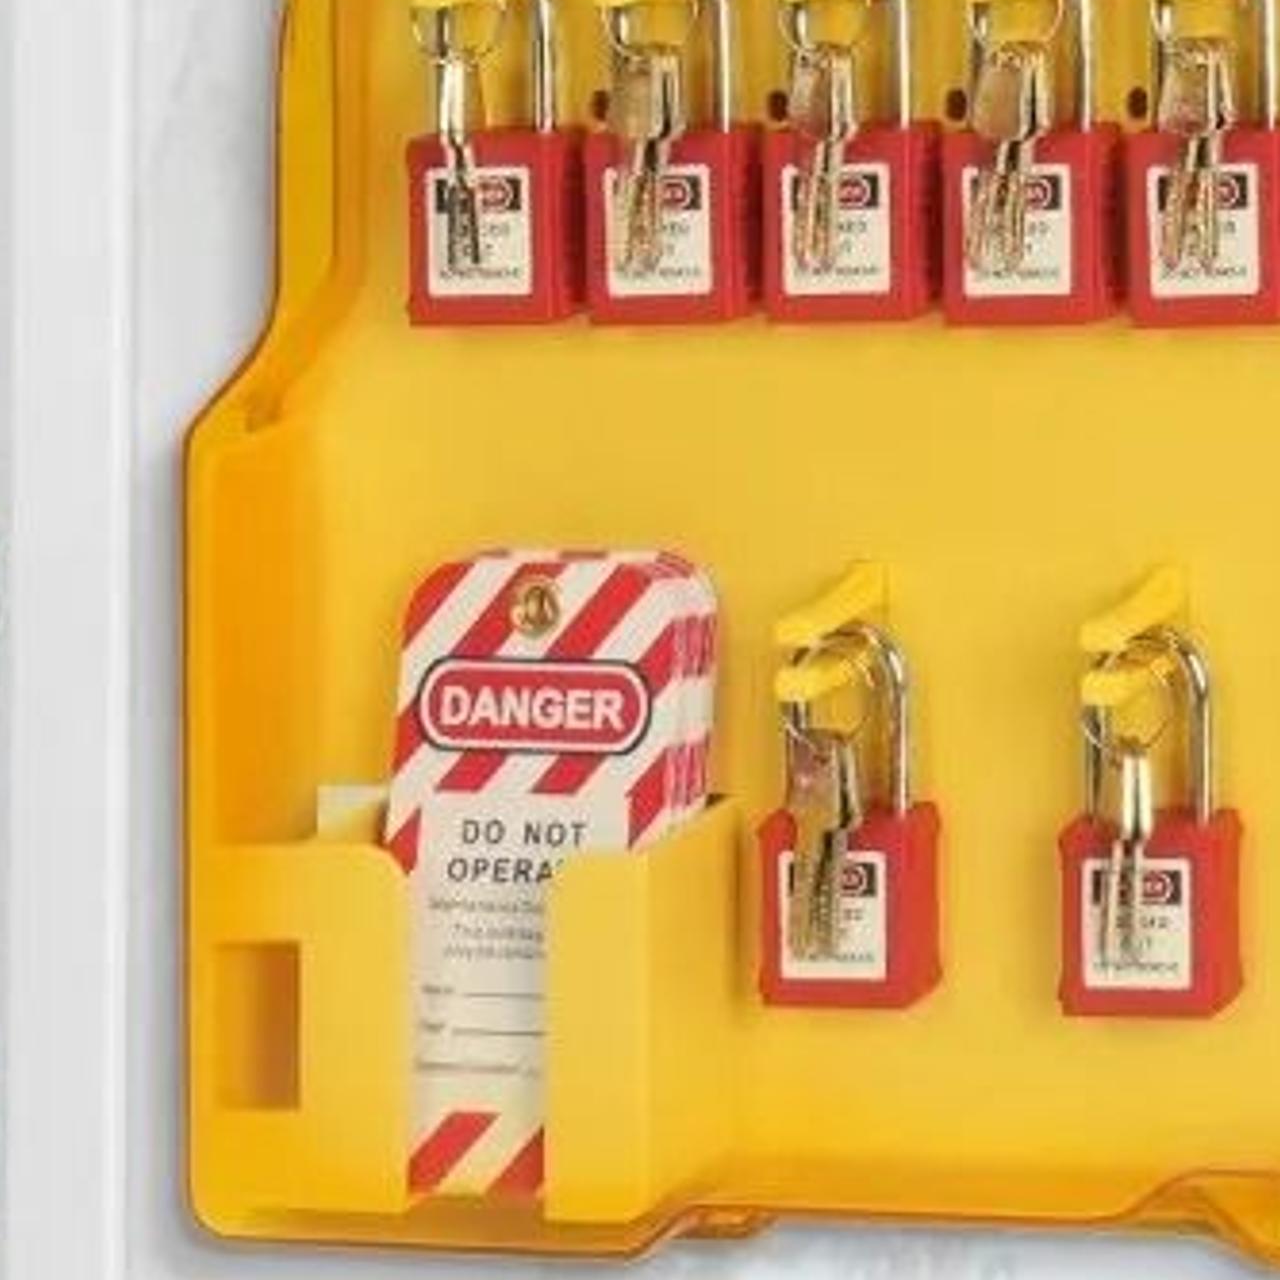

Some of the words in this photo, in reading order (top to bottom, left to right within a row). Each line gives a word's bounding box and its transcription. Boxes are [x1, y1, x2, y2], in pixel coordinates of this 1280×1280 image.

[440, 684, 626, 733] DANGER
[462, 818, 507, 845] DO
[523, 821, 588, 848] NOT
[447, 856, 565, 884] OPERA
